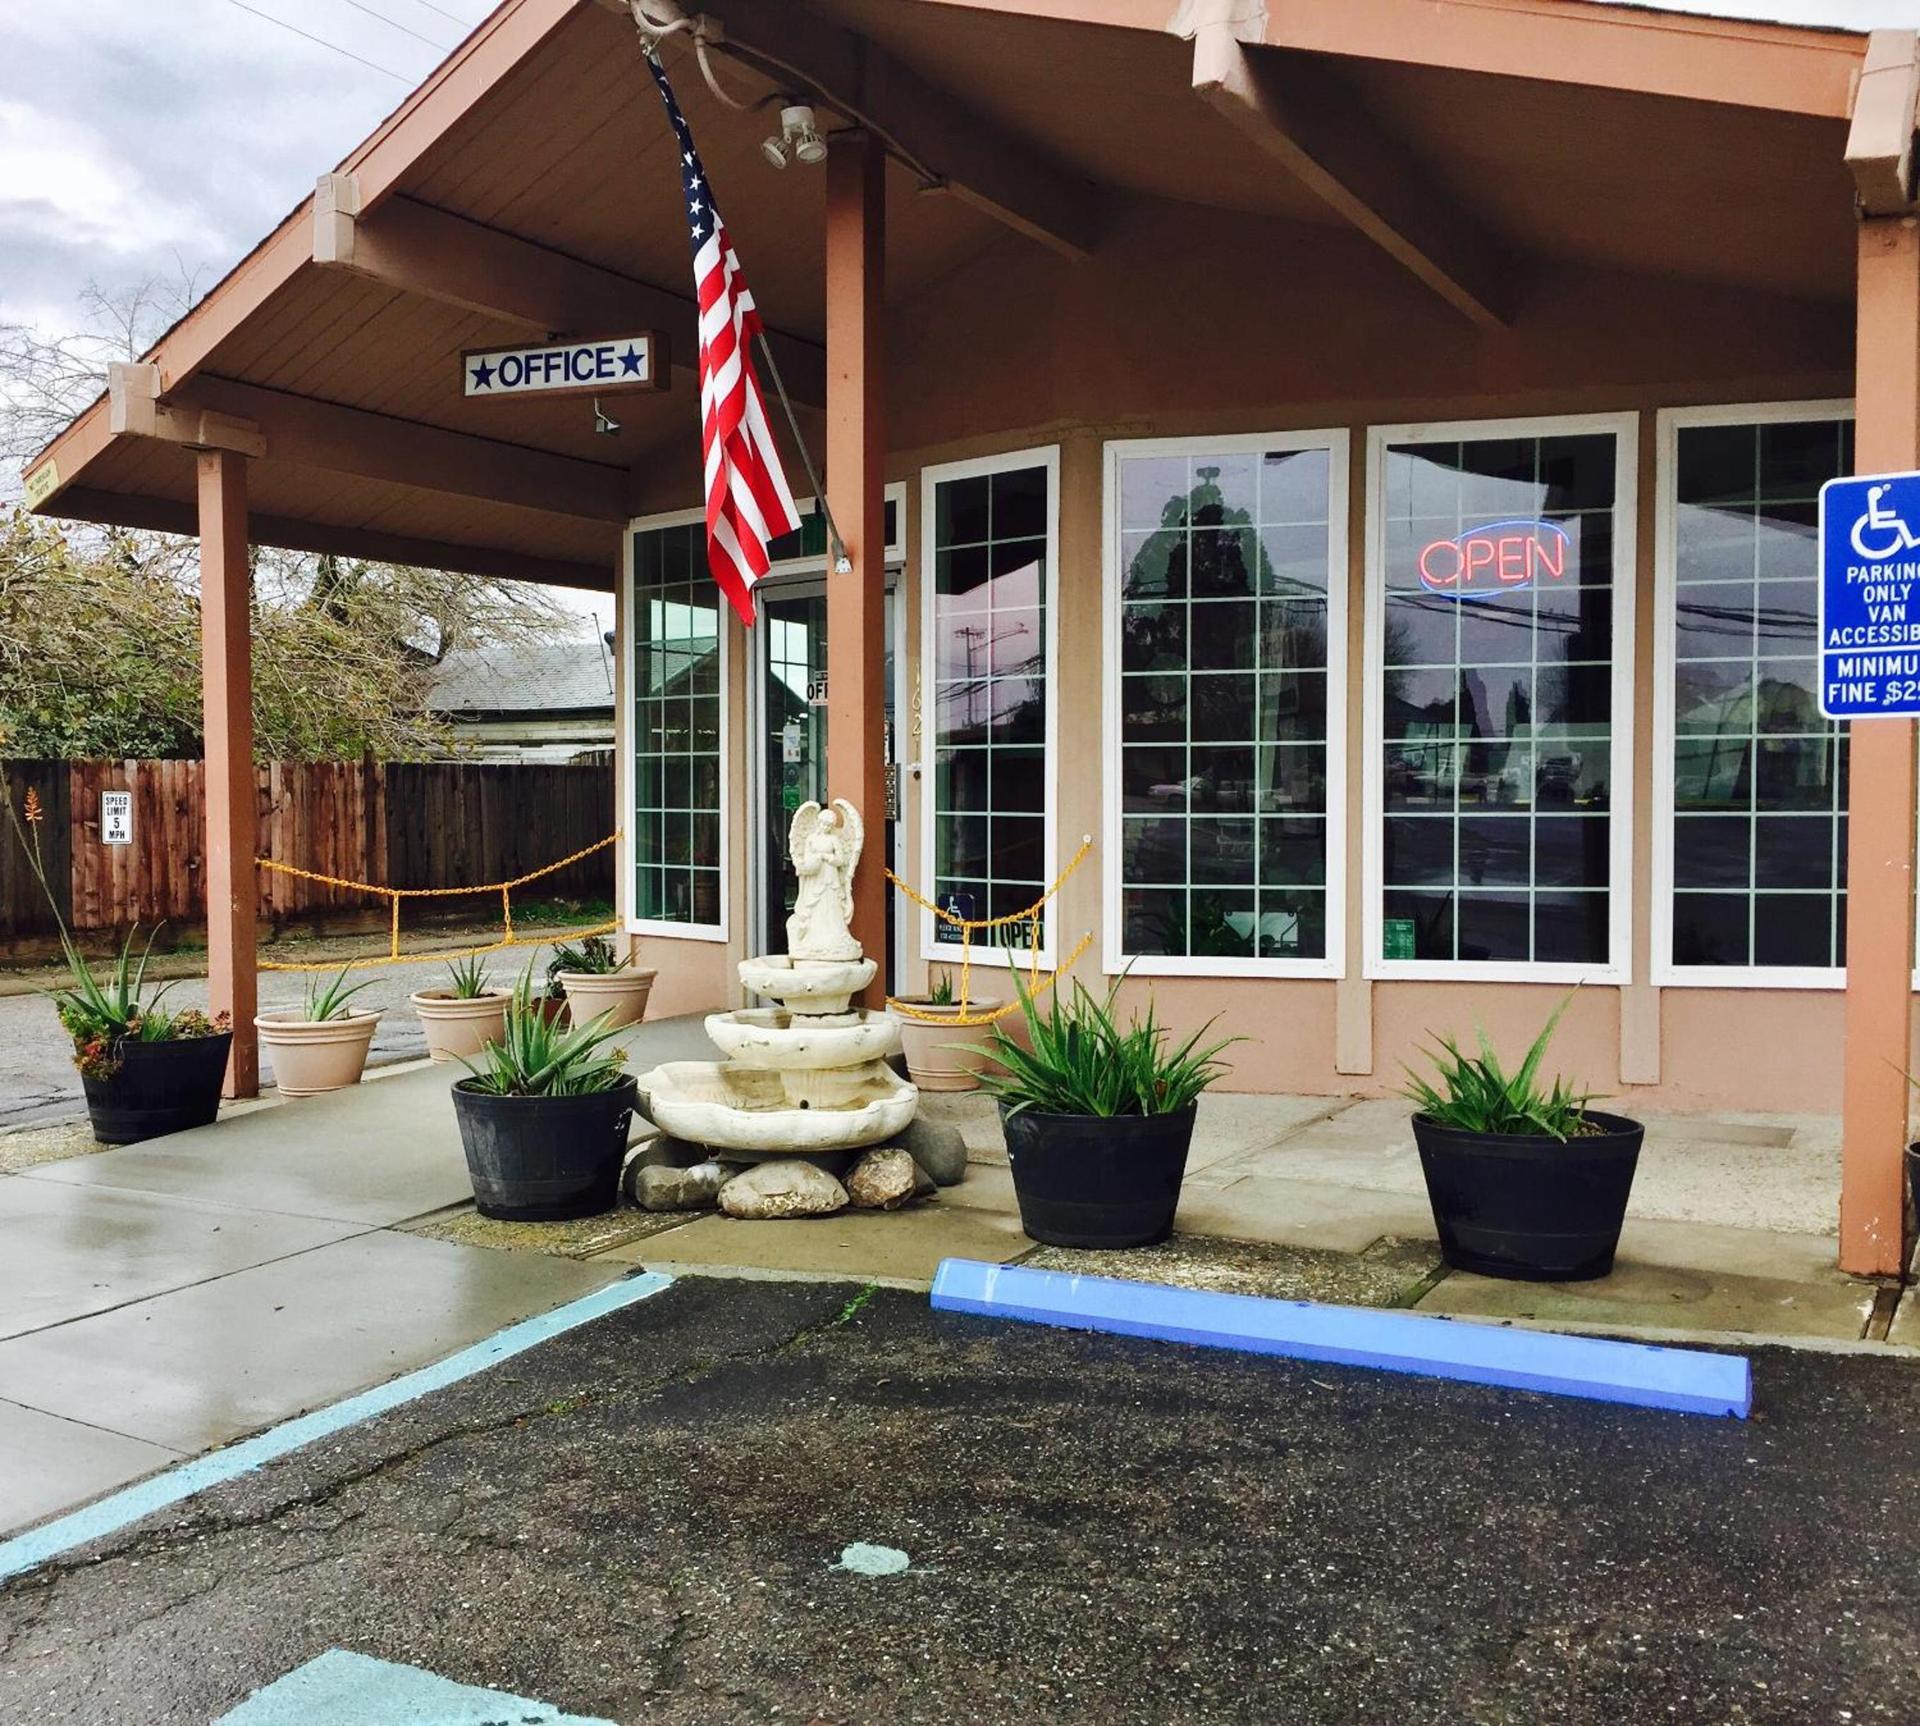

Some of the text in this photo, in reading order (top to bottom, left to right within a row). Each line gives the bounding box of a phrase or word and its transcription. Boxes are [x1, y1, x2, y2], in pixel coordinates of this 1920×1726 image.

[499, 346, 615, 387] OFFICE
[1419, 533, 1564, 584] OPEN
[1846, 562, 1920, 584] PARKIN
[1863, 583, 1912, 603] ONLY
[1868, 604, 1906, 622] VAN
[1828, 679, 1920, 704] FINE $2
[105, 796, 128, 806] SPEED
[106, 806, 127, 816] LIMIT
[113, 817, 120, 829] 5
[109, 830, 125, 839] MPH
